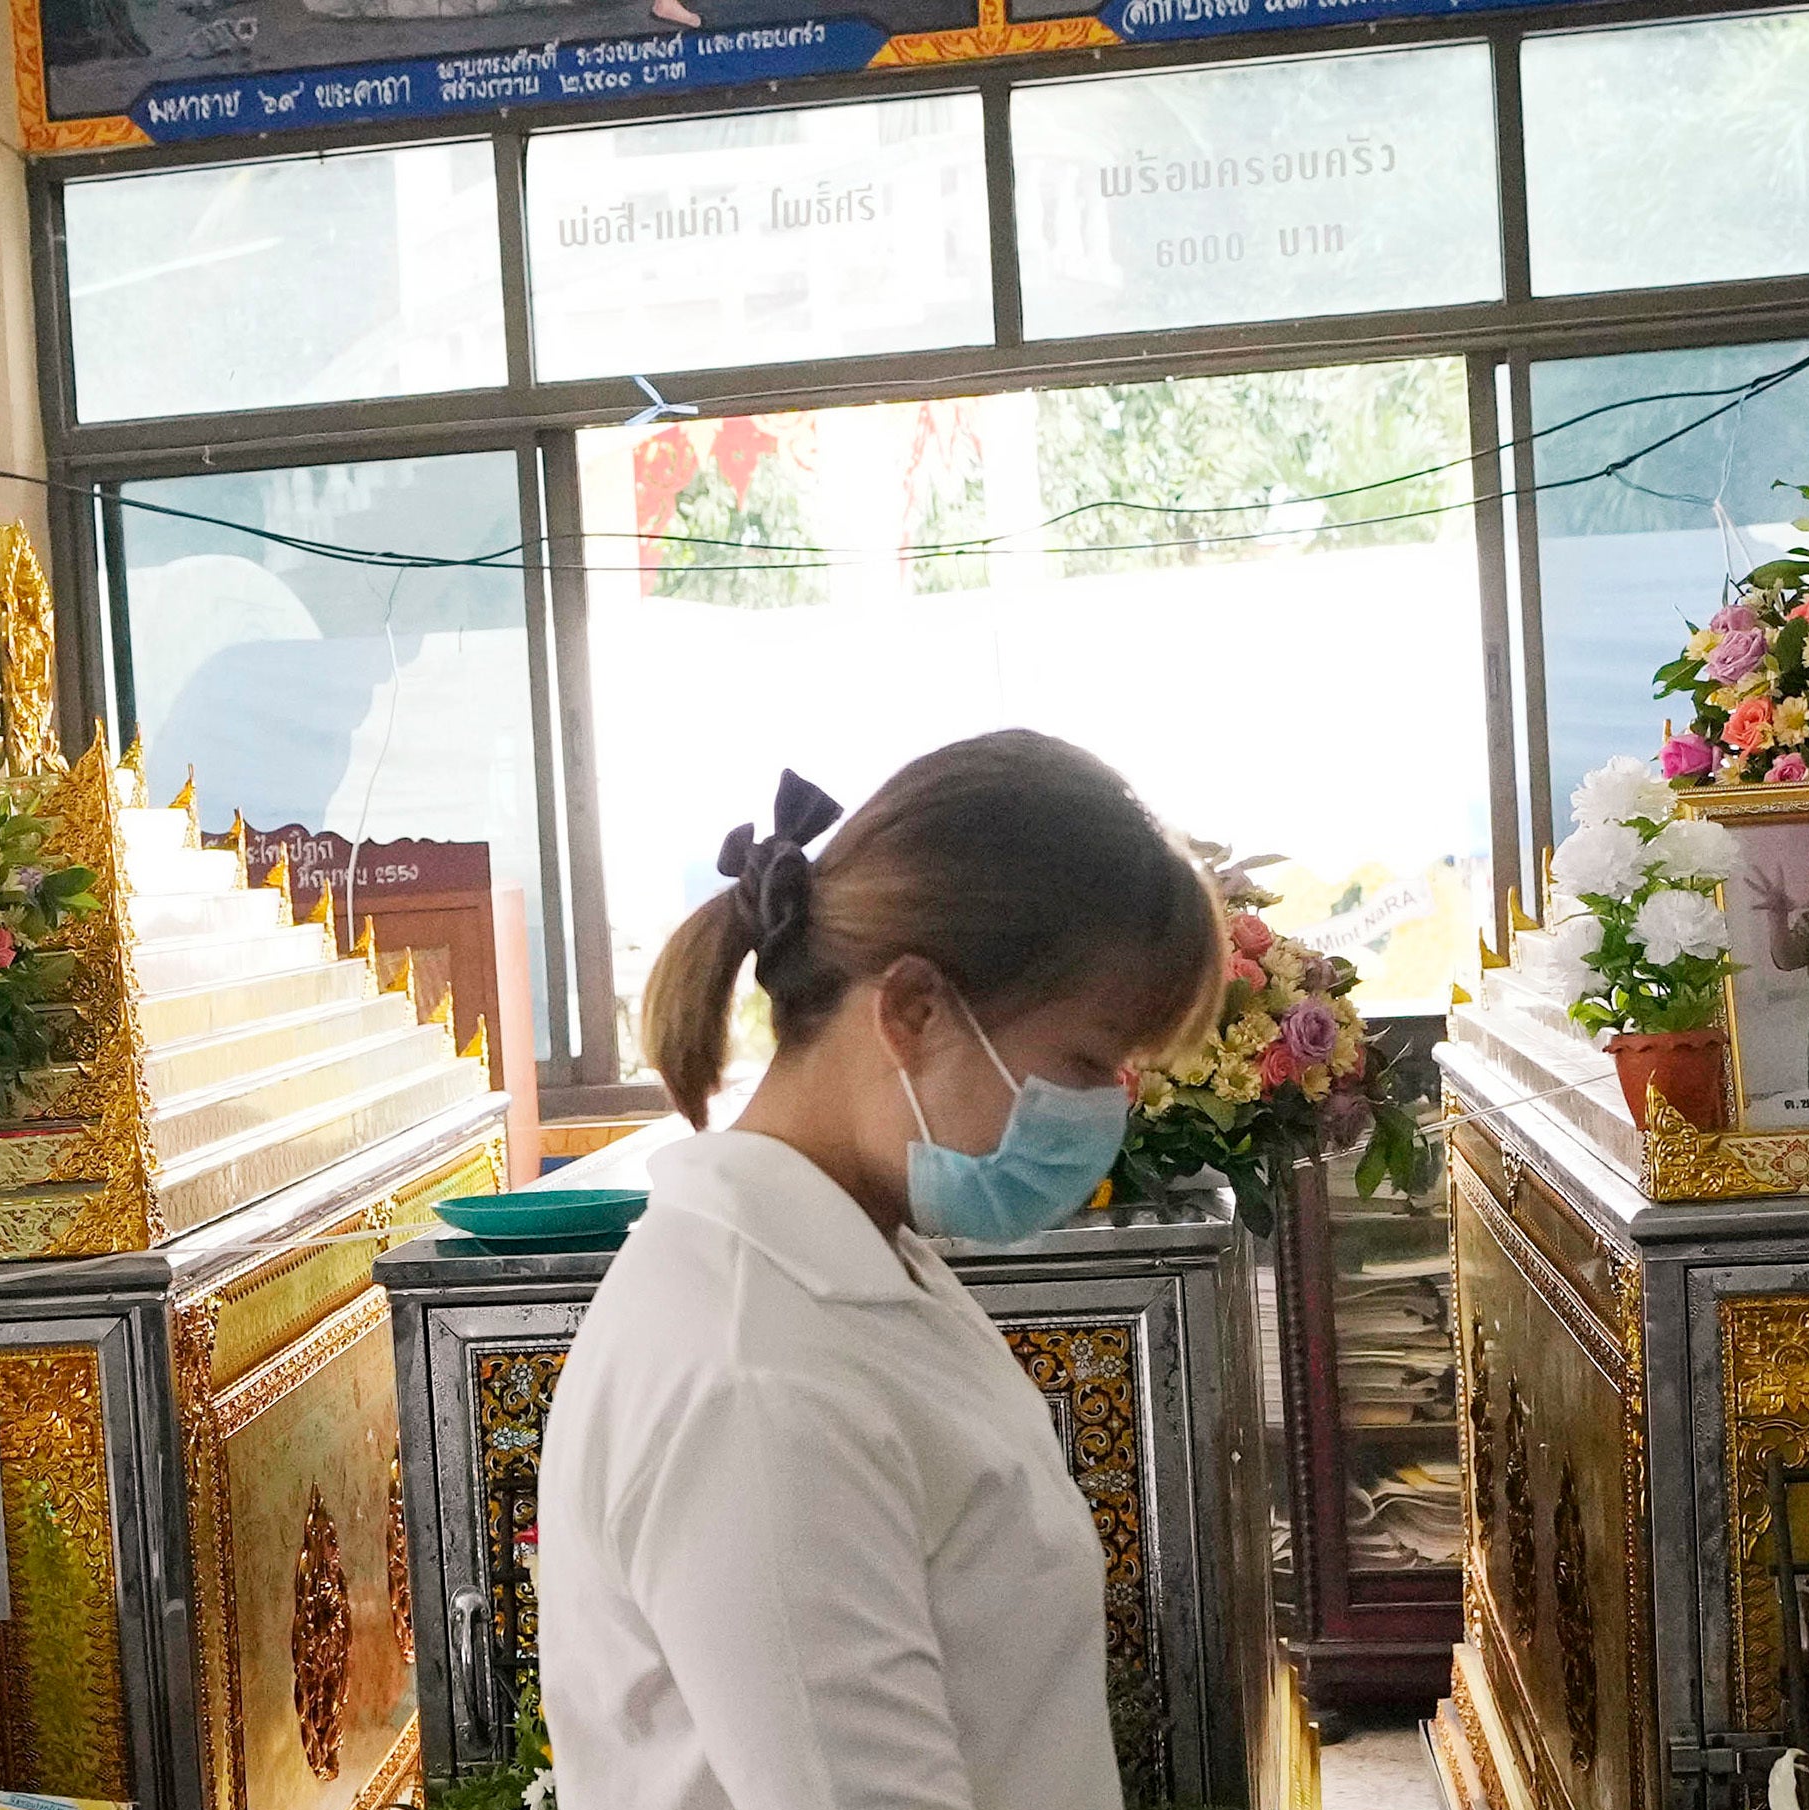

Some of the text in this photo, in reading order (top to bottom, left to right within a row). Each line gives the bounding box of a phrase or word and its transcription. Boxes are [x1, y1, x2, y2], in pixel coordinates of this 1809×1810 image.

[1099, 133, 1397, 198] พร้อมครอบครัว
[1155, 223, 1345, 269] 6000 บาท
